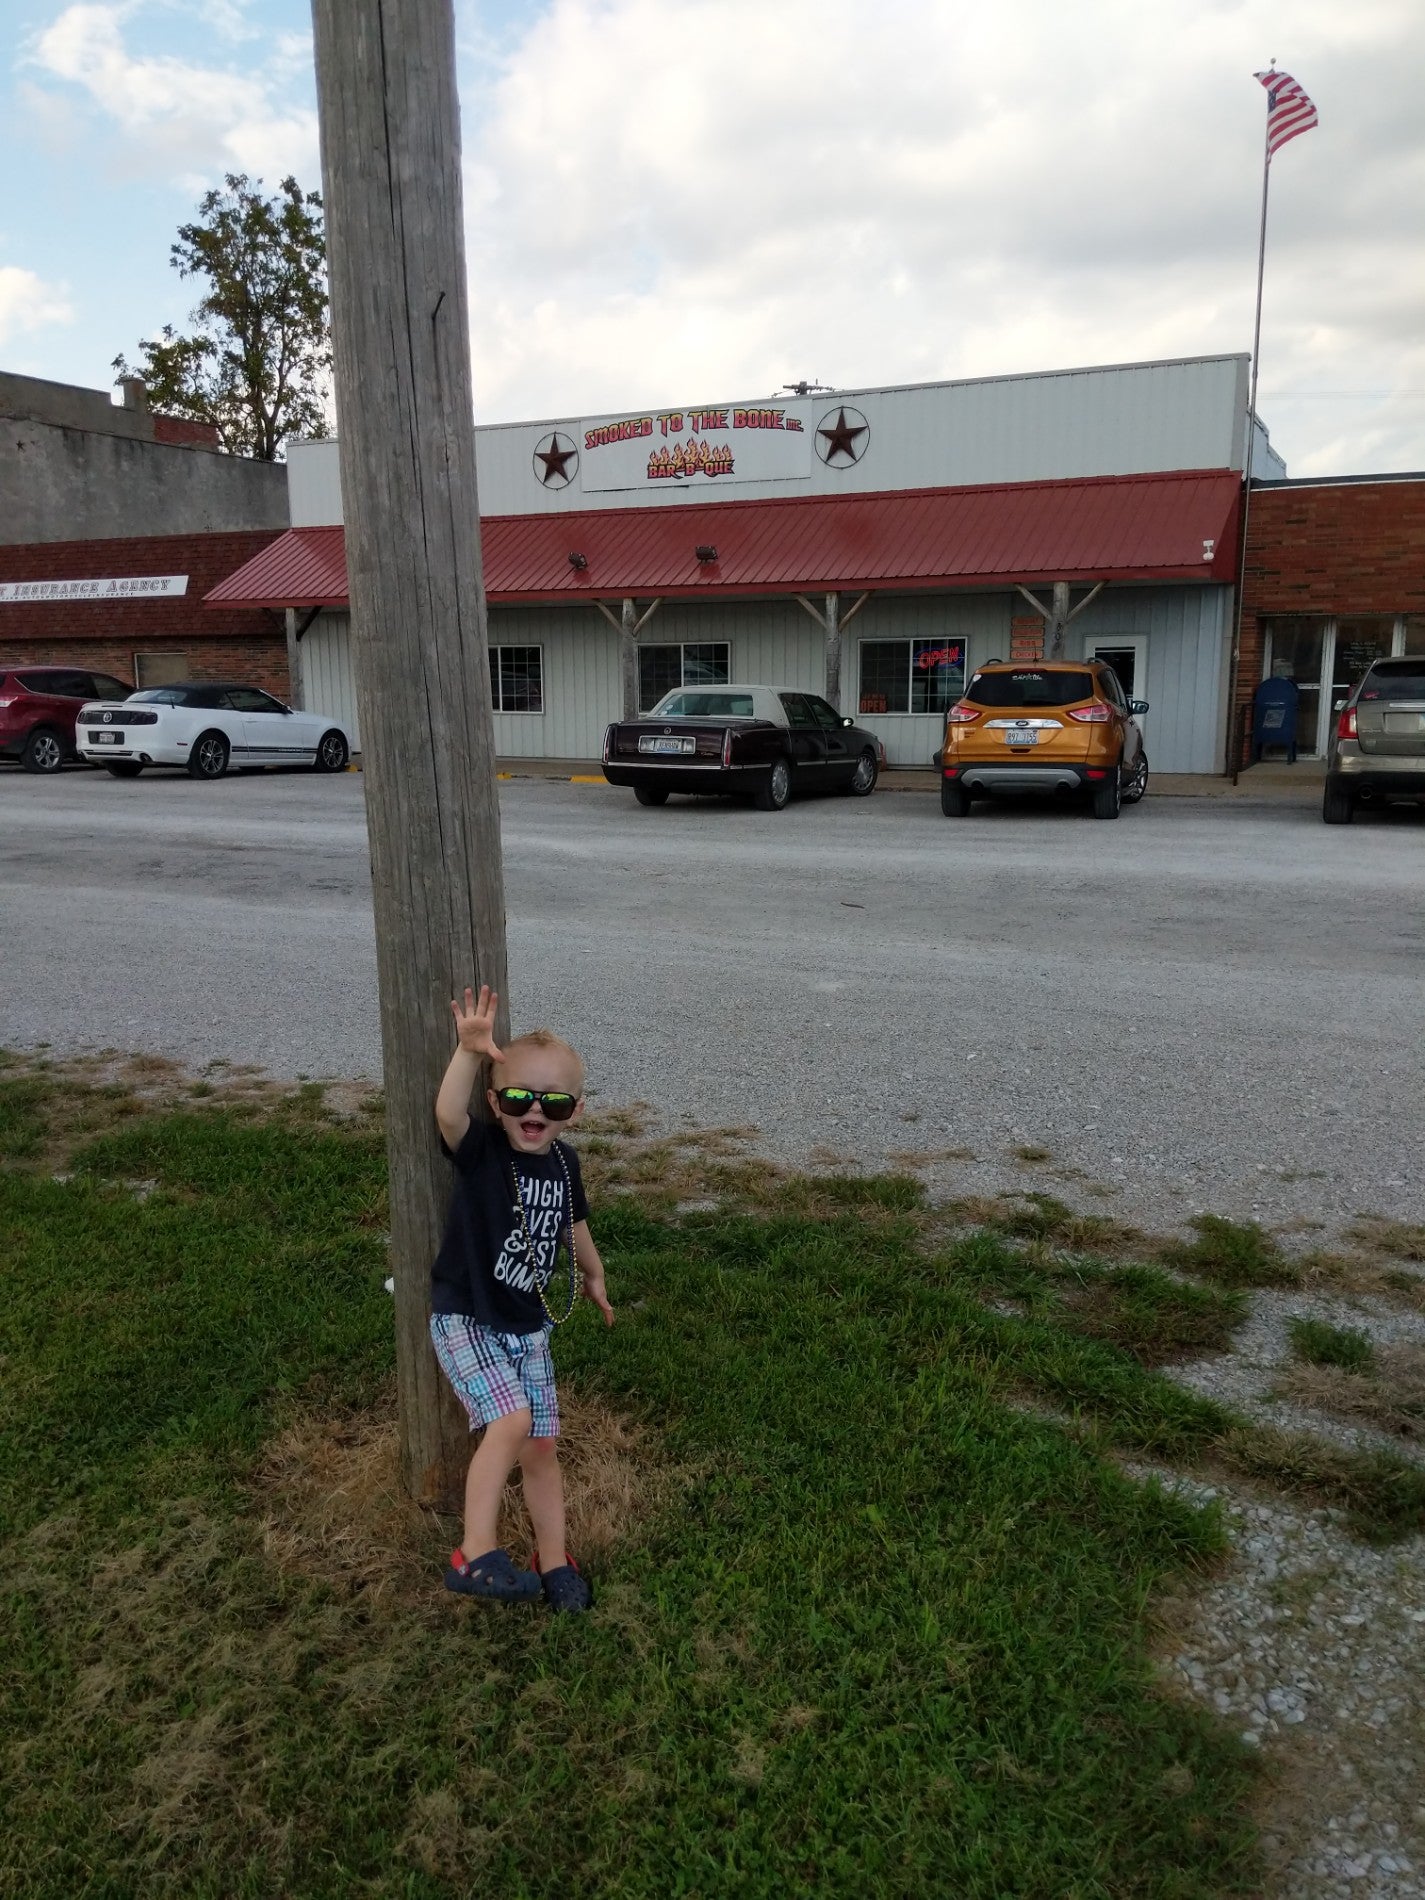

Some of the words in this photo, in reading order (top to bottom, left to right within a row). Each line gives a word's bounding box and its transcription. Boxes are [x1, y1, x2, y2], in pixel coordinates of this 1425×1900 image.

[585, 416, 653, 450] SMOKED
[657, 413, 684, 438] TO
[687, 409, 730, 435] THE
[733, 409, 786, 430] BONE
[648, 464, 682, 480] BAR
[685, 463, 696, 477] B
[704, 460, 735, 477] QUE
[13, 581, 100, 597] INSURANCE
[106, 579, 171, 593] AGENCY
[919, 646, 960, 669] OPEN
[860, 699, 887, 713] OPEN
[519, 1175, 564, 1208] HIGH
[513, 1205, 562, 1238] VES
[503, 1229, 528, 1253] &
[493, 1251, 554, 1294] BUMPS
